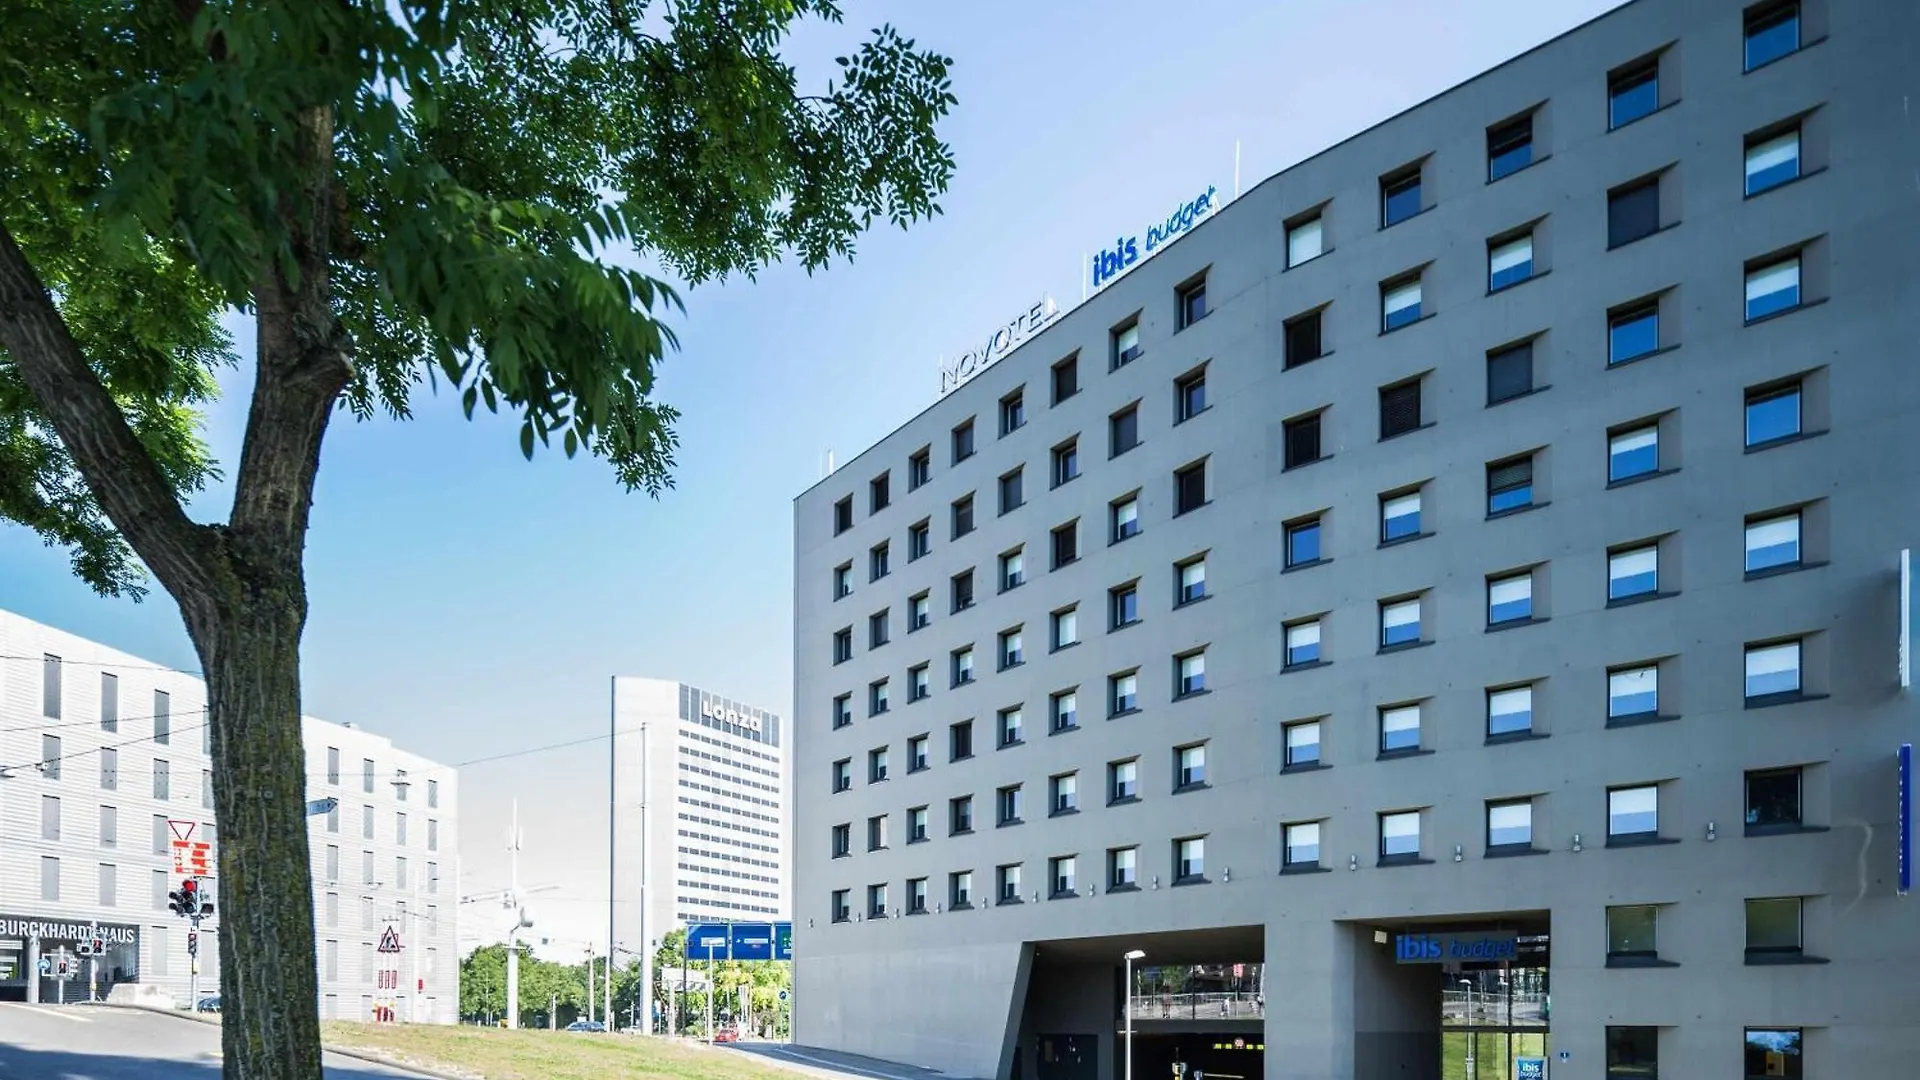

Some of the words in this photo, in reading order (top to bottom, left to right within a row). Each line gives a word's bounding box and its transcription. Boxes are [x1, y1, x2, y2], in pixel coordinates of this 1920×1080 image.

[1094, 237, 1138, 287] ibis
[1146, 184, 1216, 251] budget
[939, 291, 1060, 393] NOVOTEL
[702, 700, 761, 732] Lonza
[1396, 934, 1443, 959] ibis
[1449, 938, 1516, 960] budget
